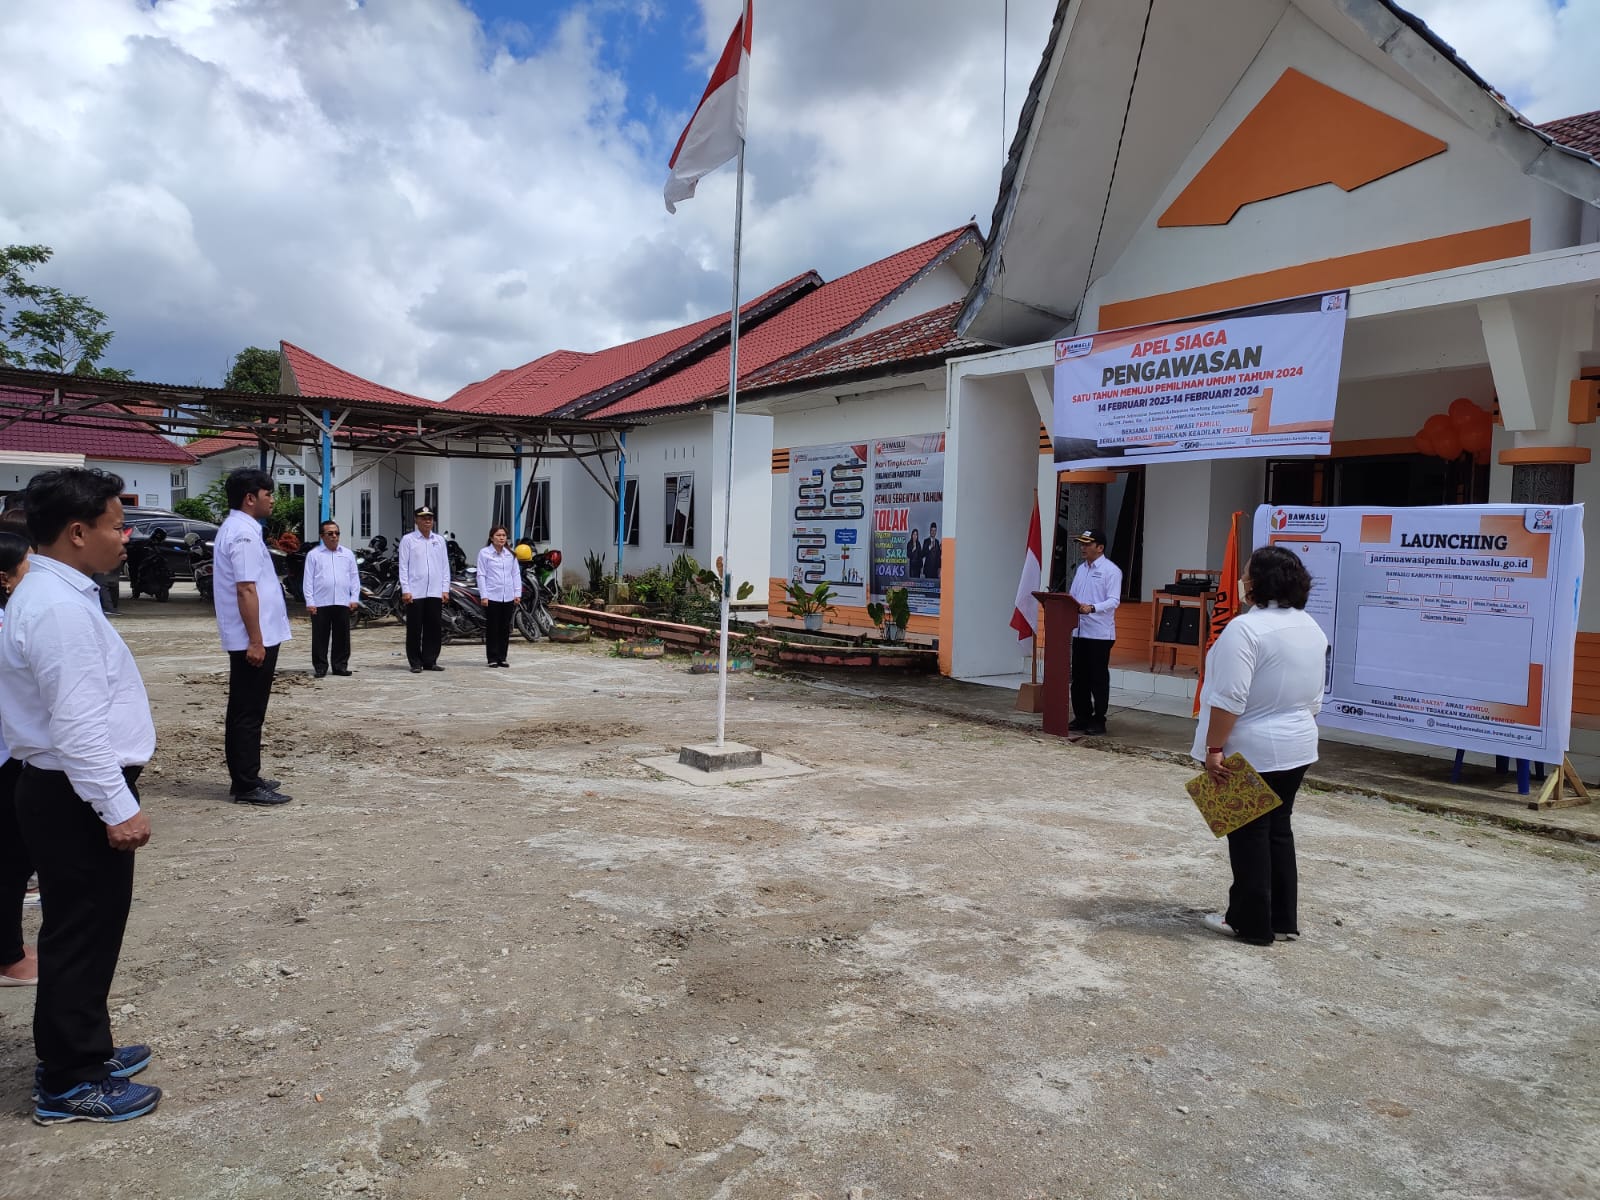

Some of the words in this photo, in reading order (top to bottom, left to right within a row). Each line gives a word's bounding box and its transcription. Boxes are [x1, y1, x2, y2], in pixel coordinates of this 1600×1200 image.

[1131, 339, 1171, 358] APEL
[1174, 329, 1227, 351] SIAGA
[1102, 345, 1263, 387] PENGAWASAN
[1072, 394, 1091, 404] SATU
[1093, 390, 1119, 401] TAHUN
[1120, 384, 1153, 397] MENUJU
[1155, 378, 1204, 393] PEMILIHAN
[1206, 375, 1236, 387] UMUM
[1238, 370, 1274, 382] TAHUN
[1276, 366, 1304, 378] 2024
[1098, 403, 1107, 412] 14
[1107, 398, 1148, 411] FEBRUARI
[1149, 394, 1183, 406] 2023-14
[1184, 388, 1232, 402] FEBRUARI
[1233, 385, 1259, 397] 2024
[1175, 422, 1195, 430] AWASI
[1188, 428, 1221, 437] KEADILAN
[1222, 426, 1249, 434] PEMILU
[922, 491, 944, 503] TAHUN
[874, 508, 909, 532] TOLAK
[1287, 513, 1326, 521] BAWASLU
[1400, 533, 1508, 550] LAUNCHING
[885, 548, 908, 559] SARA
[1369, 554, 1528, 570] jarimuawasipemilu.bawaslu.go.id
